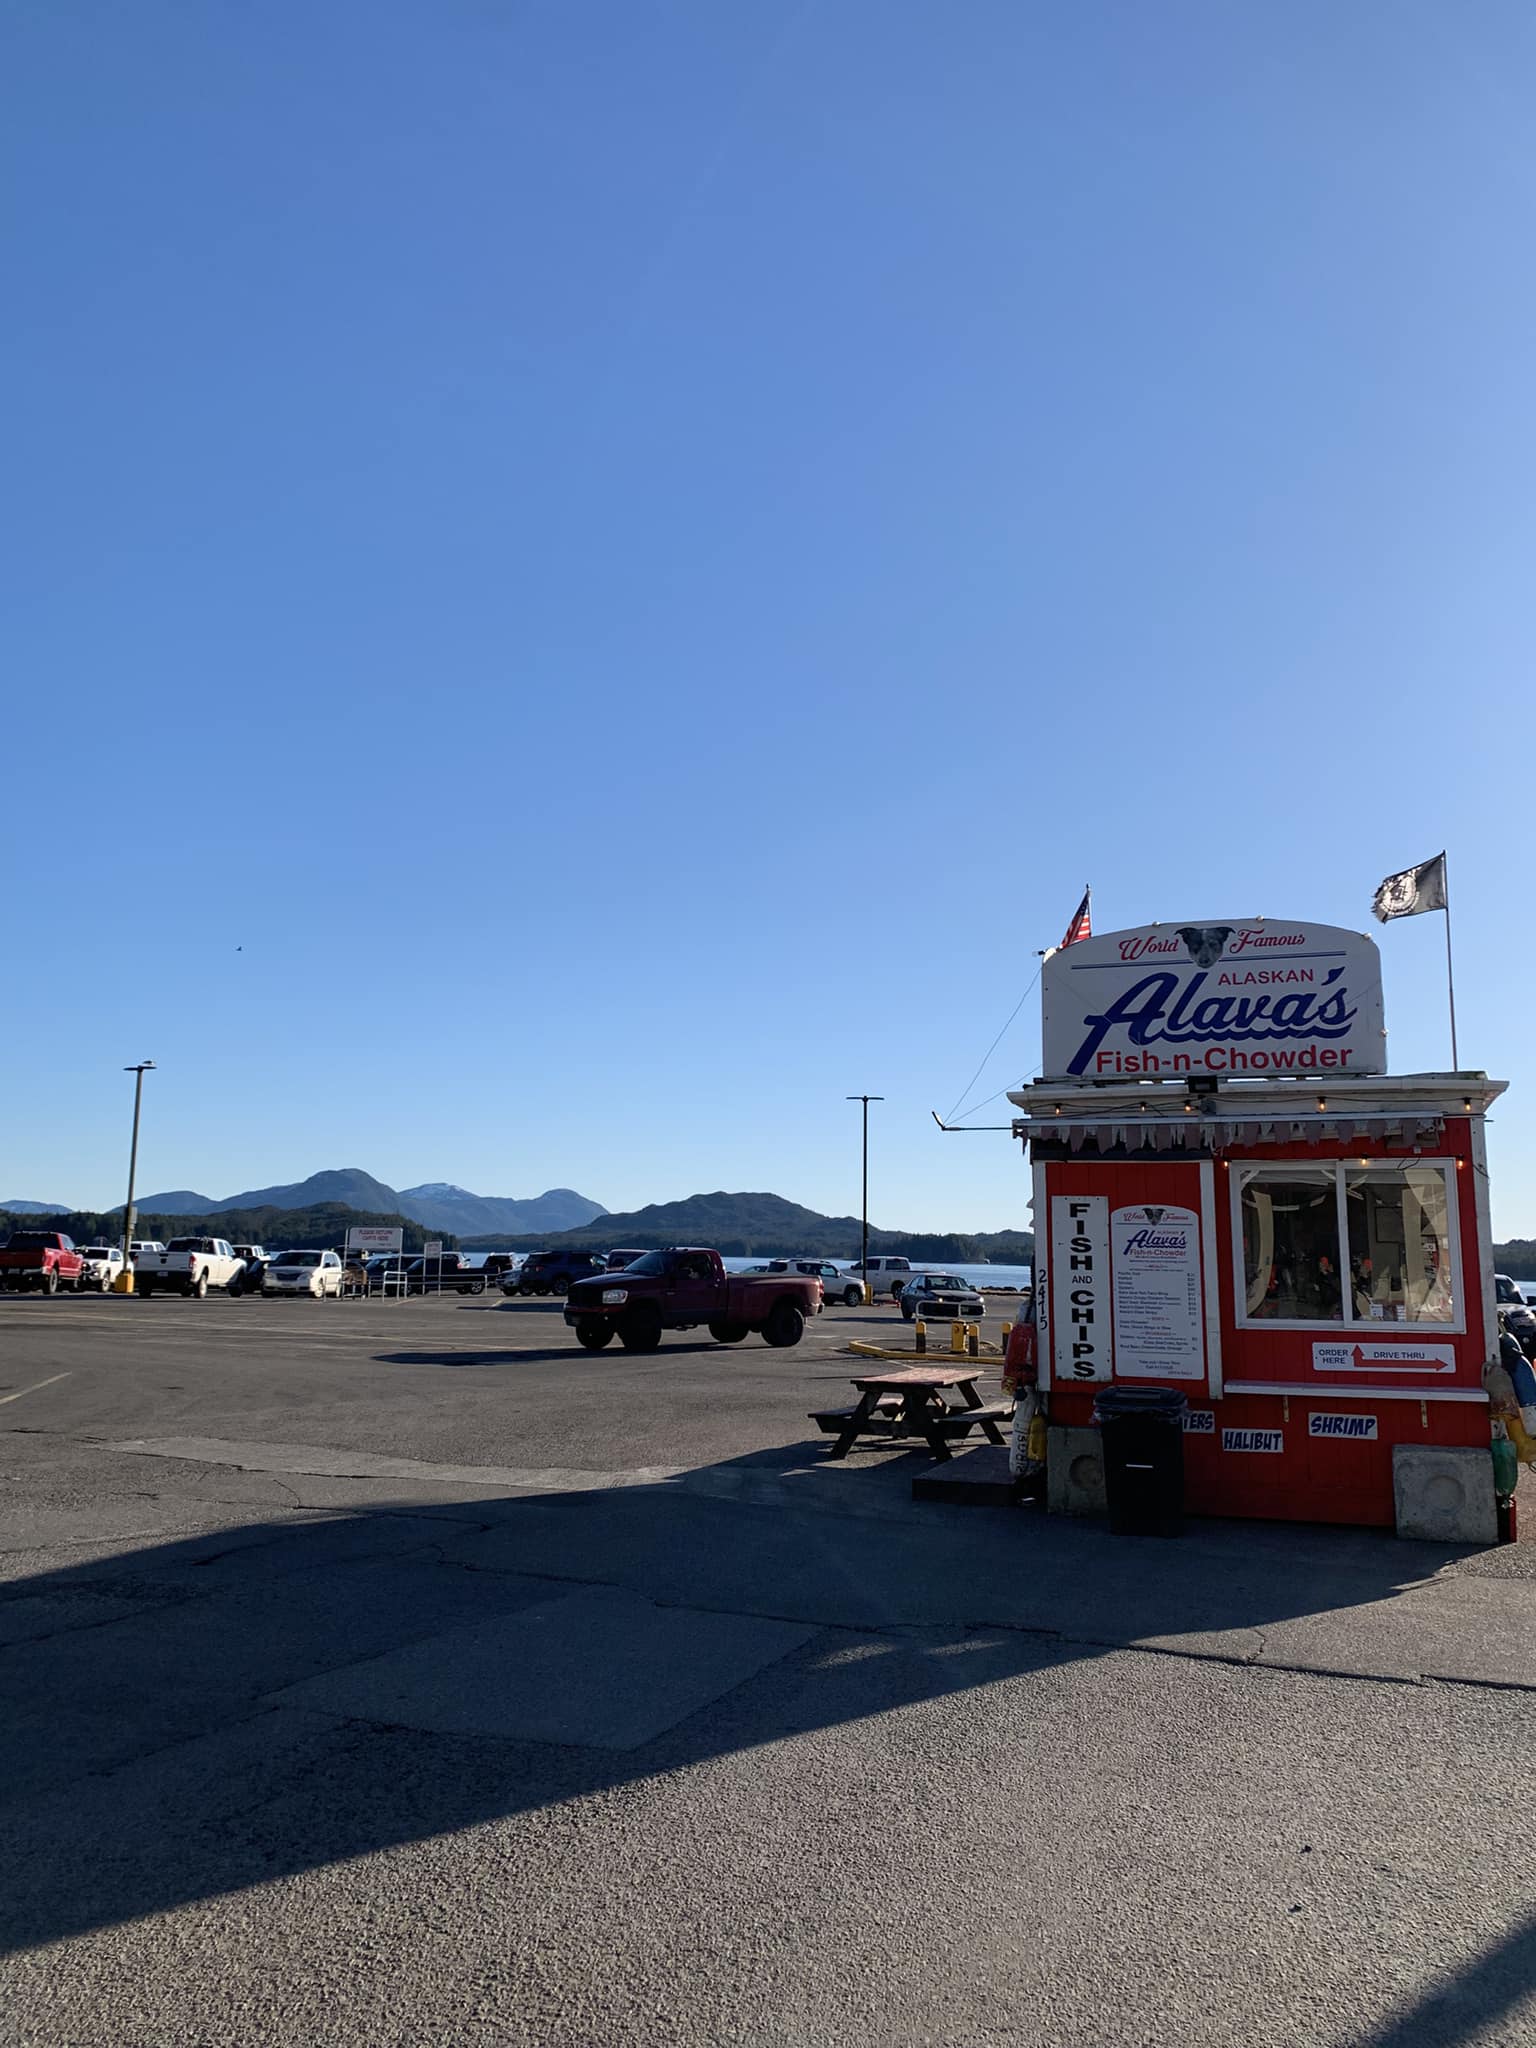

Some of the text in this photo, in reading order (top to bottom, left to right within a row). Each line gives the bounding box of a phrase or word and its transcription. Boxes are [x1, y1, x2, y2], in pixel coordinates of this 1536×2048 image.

[1118, 928, 1305, 961] World Famous
[1217, 968, 1314, 986] ALASKAN
[1066, 966, 1358, 1076] Alava's
[1096, 1045, 1353, 1073] Fish-n-Chowder
[1123, 1229, 1188, 1255] Alava's
[1038, 1269, 1048, 1330] 2415
[1069, 1203, 1096, 1378] FISH AND CHIPS
[1318, 1349, 1348, 1357] ORDER
[1373, 1351, 1425, 1359] DRIVE THRU
[1310, 1415, 1376, 1436] SHRIMP
[1223, 1431, 1282, 1451] HALIBUT
